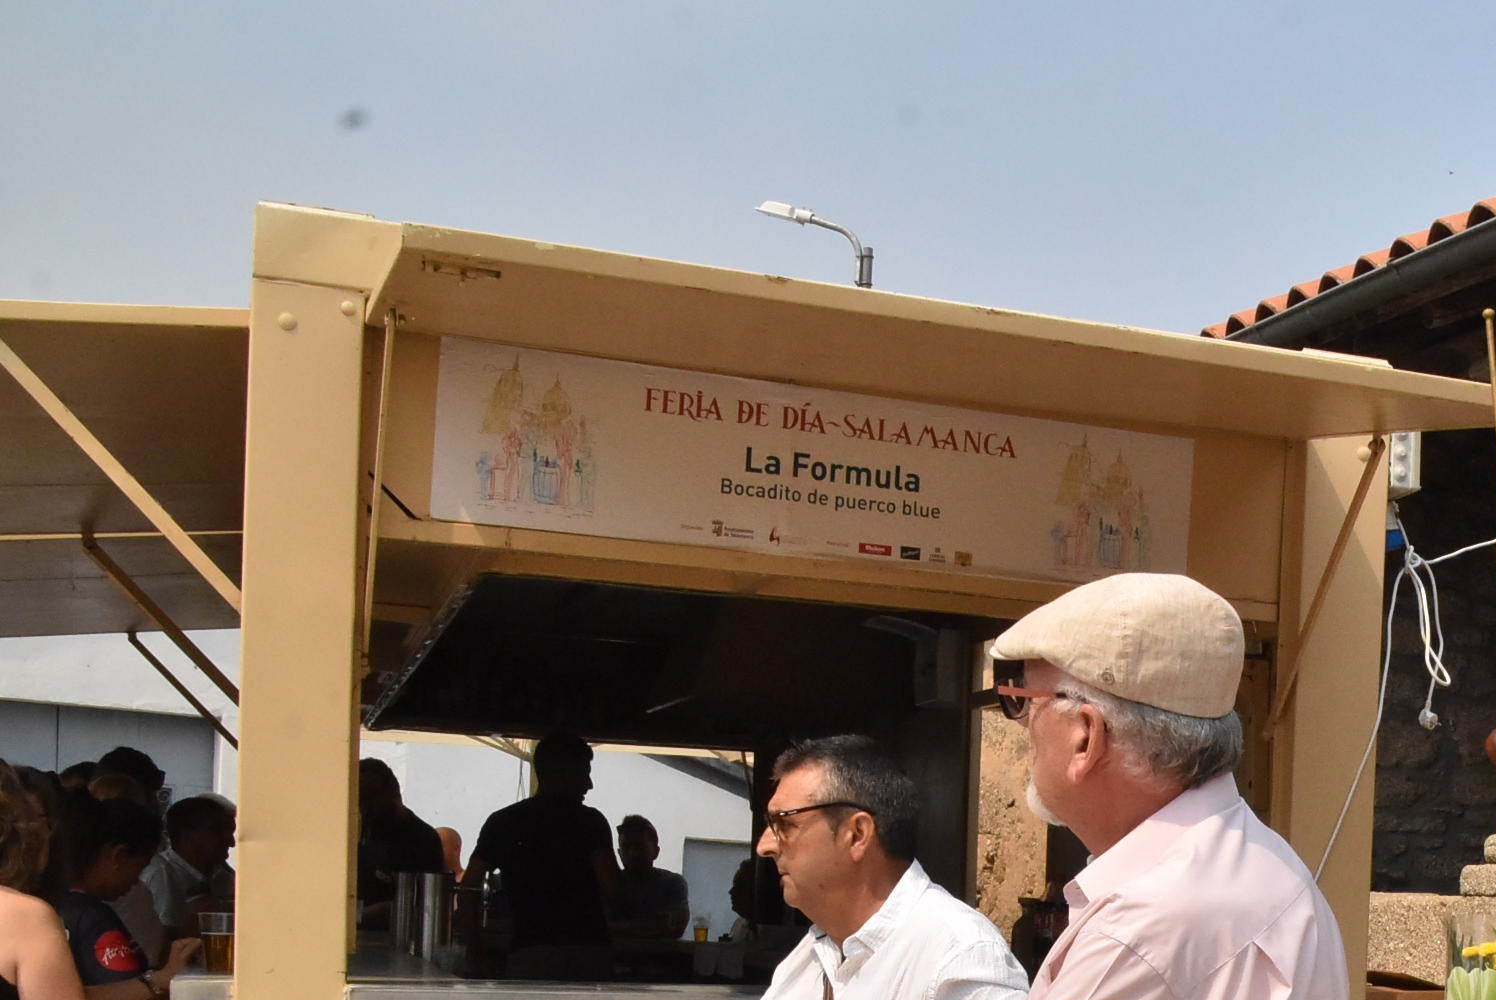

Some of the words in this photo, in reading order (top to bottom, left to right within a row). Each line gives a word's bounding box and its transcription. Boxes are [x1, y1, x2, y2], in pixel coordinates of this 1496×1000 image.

[737, 399, 769, 427] DE
[745, 446, 781, 476] La
[792, 451, 921, 493] Formula
[720, 477, 802, 503] Bocadito
[807, 488, 829, 506] de
[834, 495, 896, 514] puerco
[902, 500, 941, 519] blue
